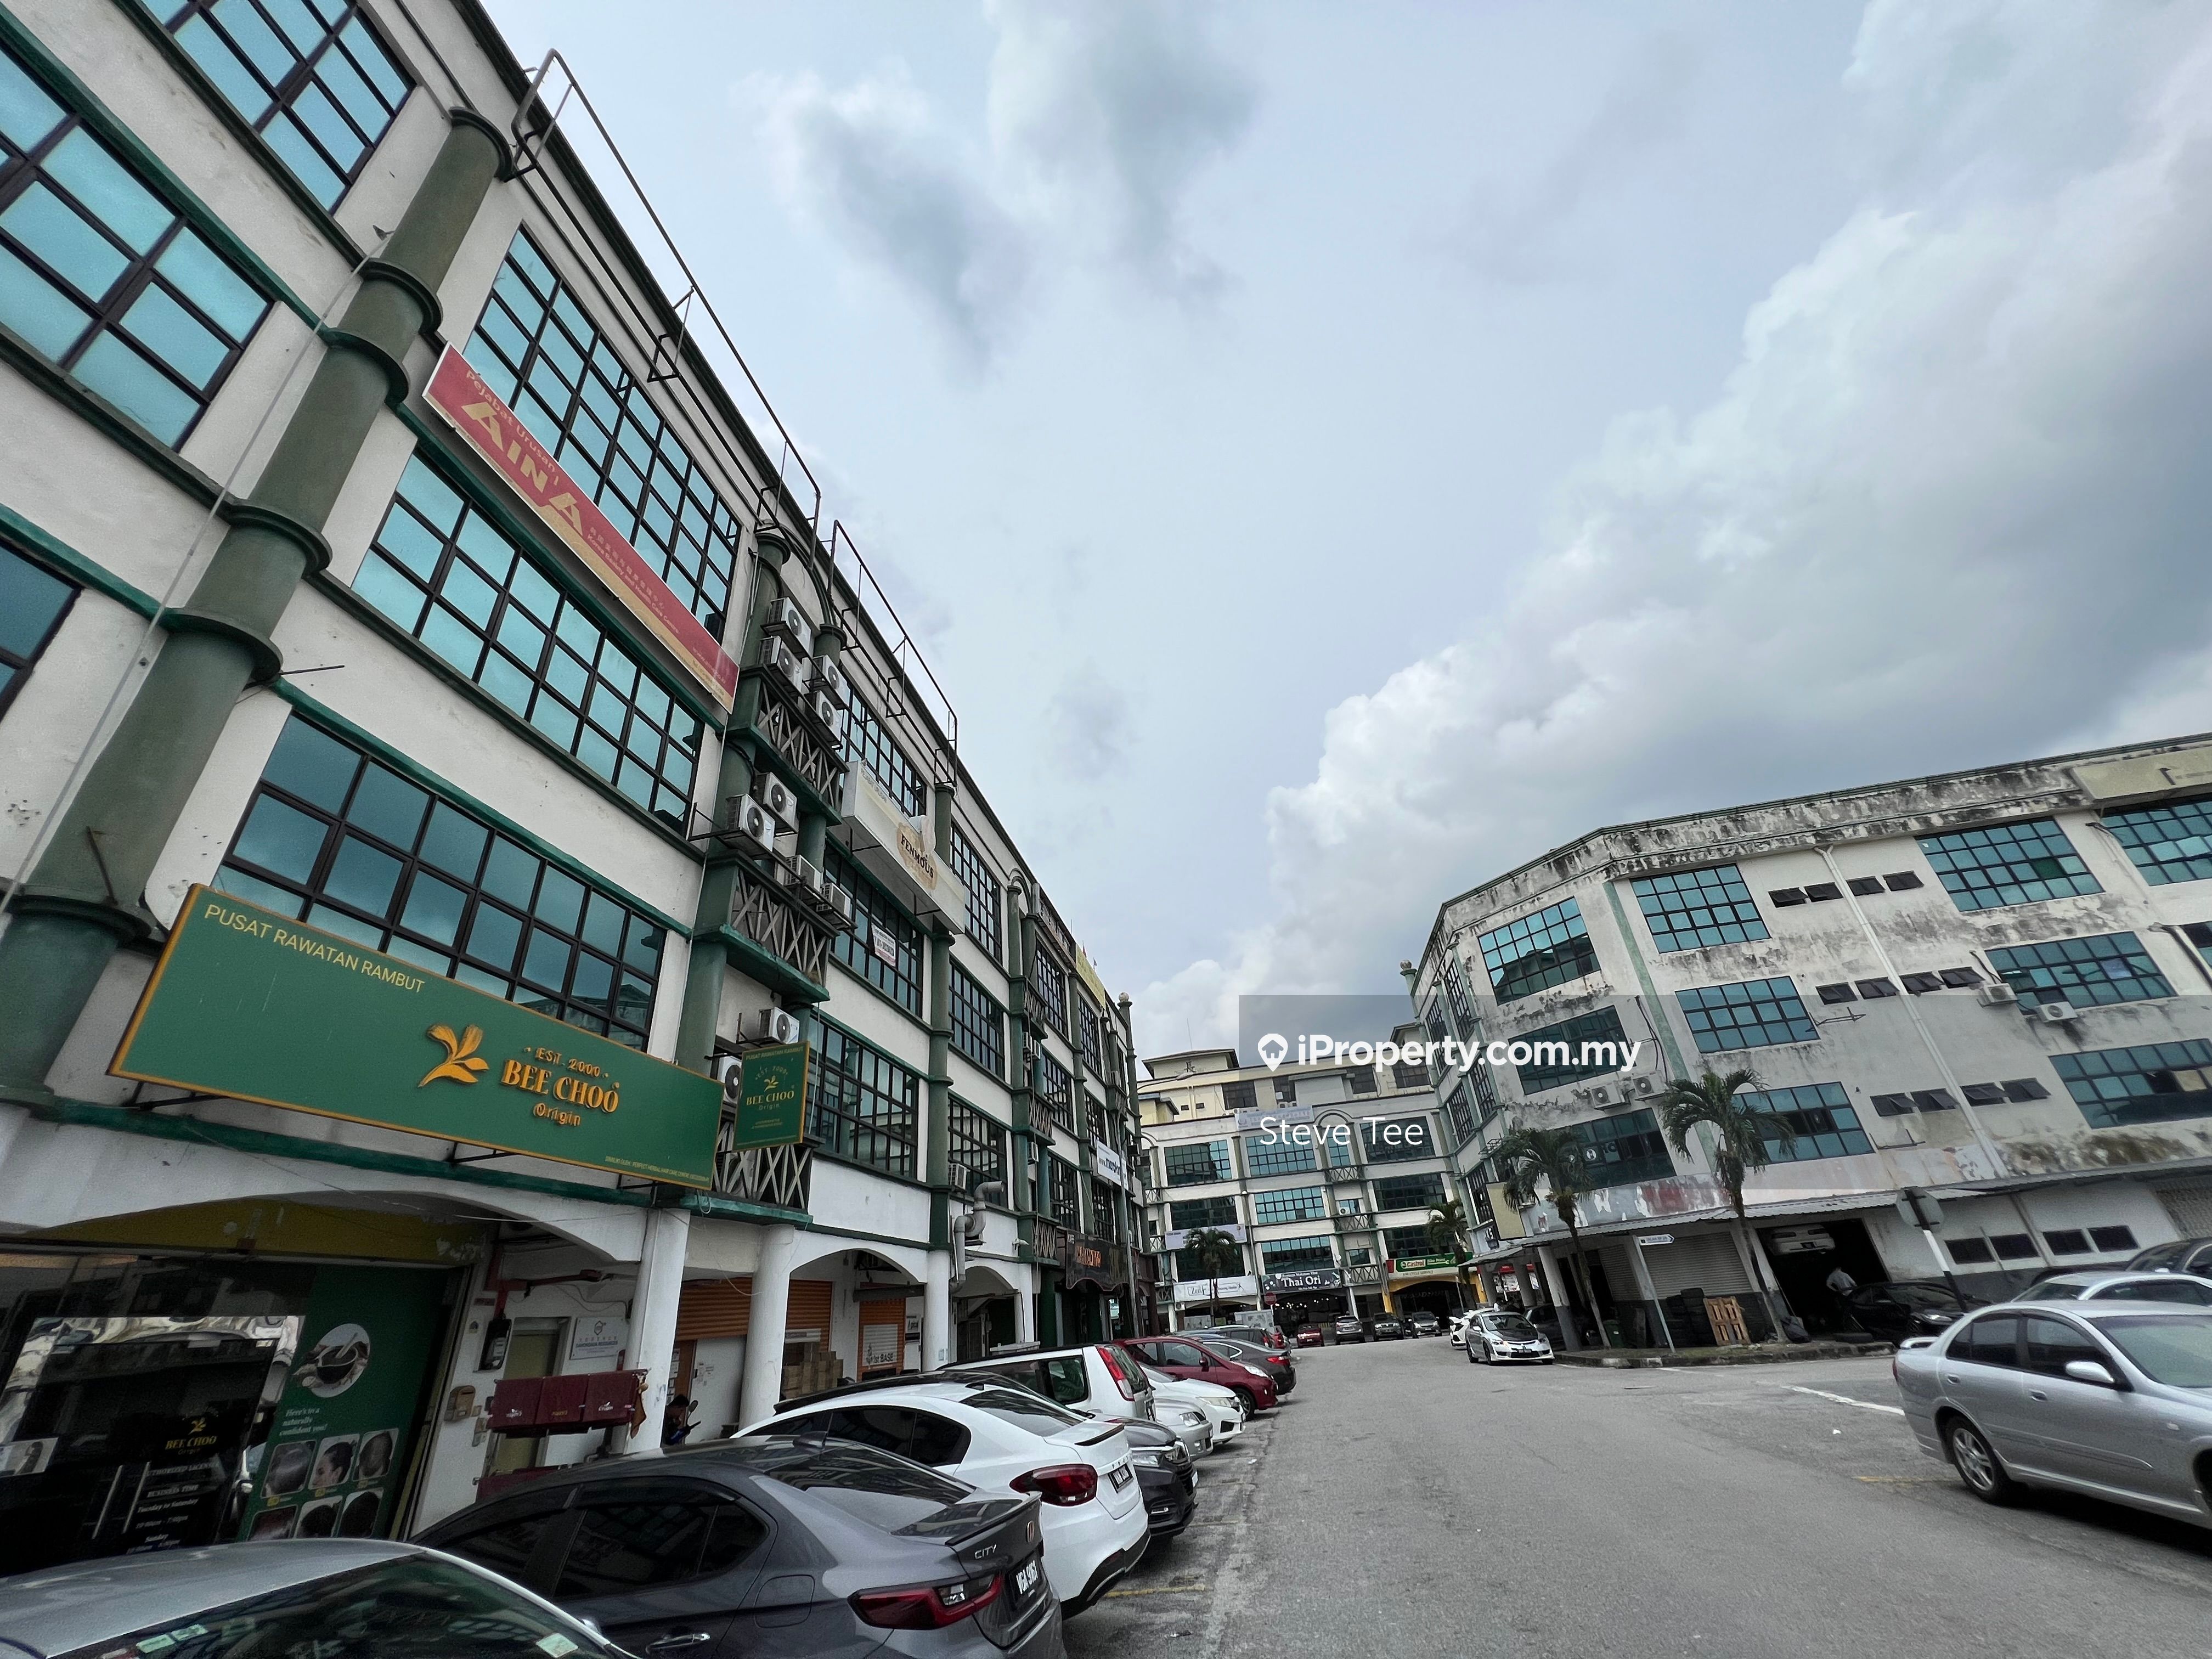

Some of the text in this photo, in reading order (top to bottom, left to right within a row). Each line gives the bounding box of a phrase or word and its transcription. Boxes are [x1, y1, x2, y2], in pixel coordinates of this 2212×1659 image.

[465, 369, 514, 426] Pejabat
[515, 424, 556, 473] Urusan
[587, 533, 605, 555] Korea
[651, 601, 663, 618] Care
[204, 904, 425, 993] PUSAT RAWATAN RAMBUT
[567, 1058, 600, 1077] 2000
[501, 1059, 619, 1113] BEE CHOO
[746, 1090, 794, 1106] BEE CHOO
[533, 1103, 581, 1126] Origin
[1281, 1275, 1321, 1287] Thai Ori
[165, 1435, 217, 1451] BEE CHOO
[974, 1544, 997, 1559] CITY
